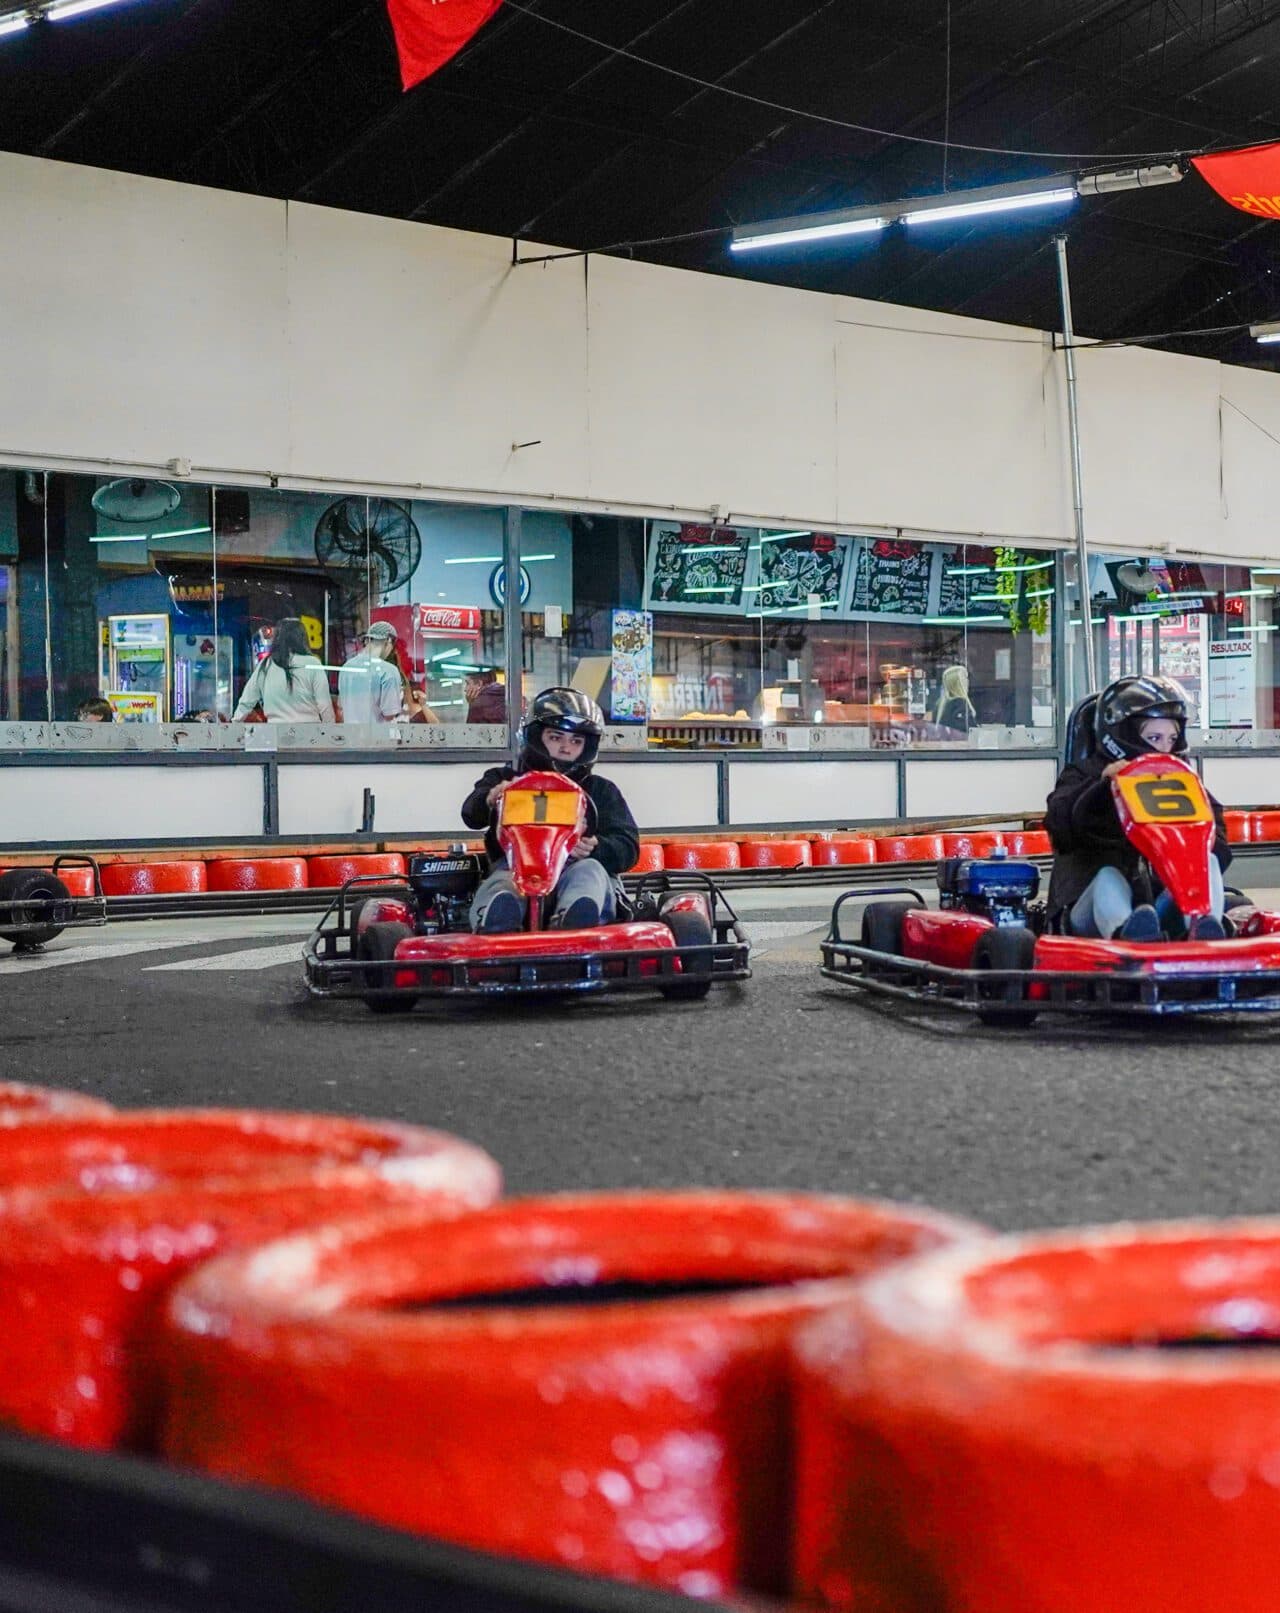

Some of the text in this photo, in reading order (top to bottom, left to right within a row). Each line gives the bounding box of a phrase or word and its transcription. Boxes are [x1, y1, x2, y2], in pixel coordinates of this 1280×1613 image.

[533, 794, 548, 822] 1
[1135, 779, 1197, 817] 6
[422, 859, 471, 873] SHIMURA
